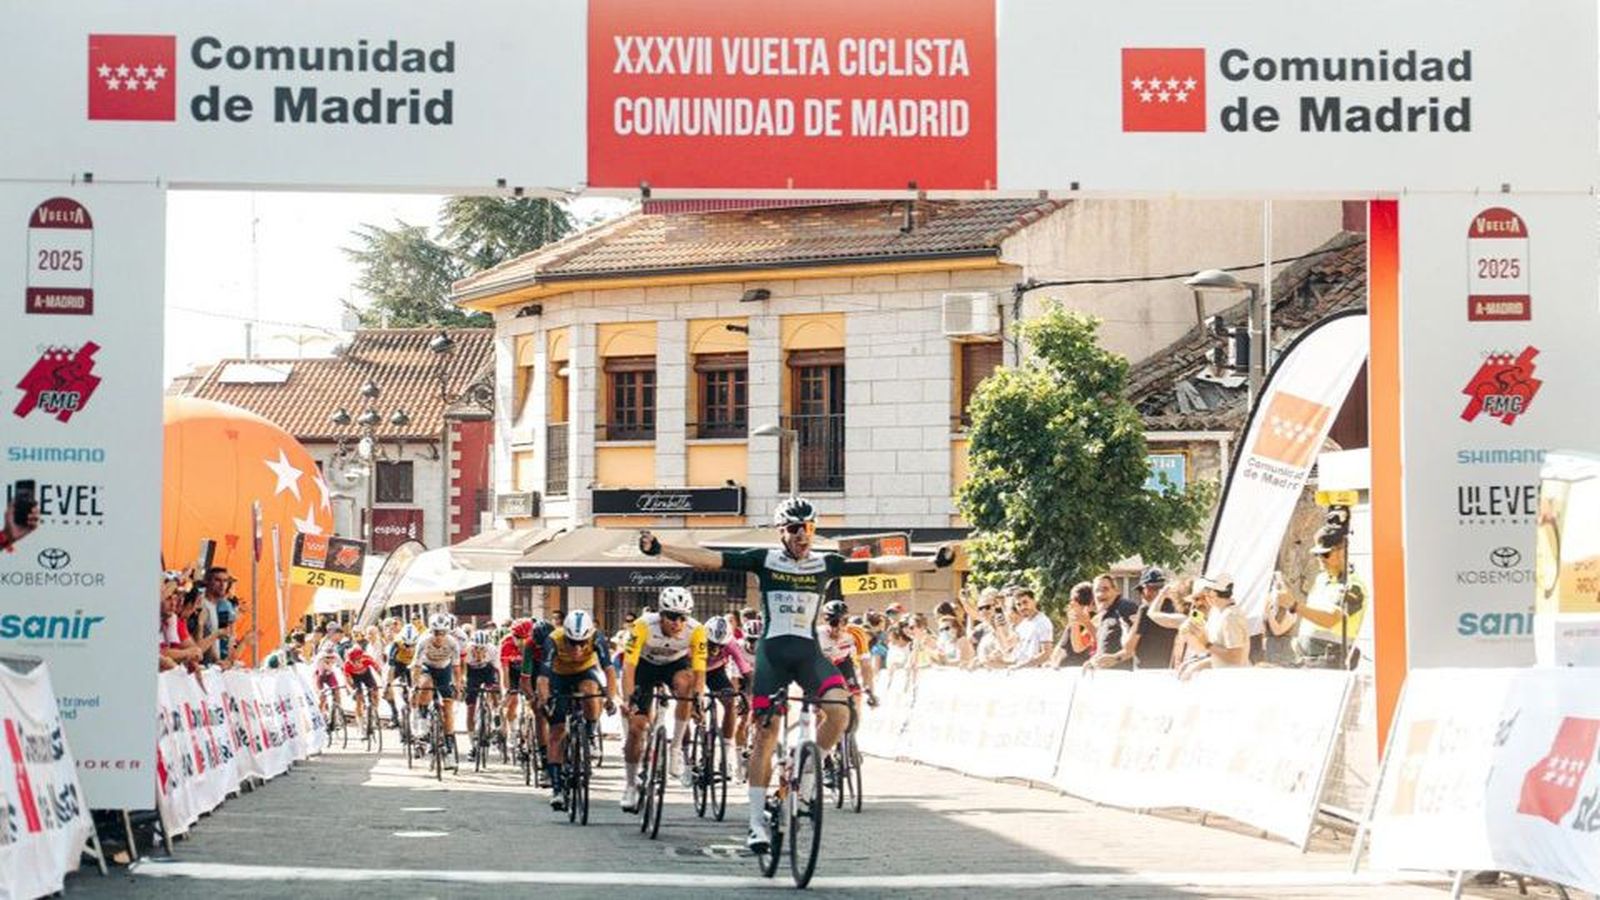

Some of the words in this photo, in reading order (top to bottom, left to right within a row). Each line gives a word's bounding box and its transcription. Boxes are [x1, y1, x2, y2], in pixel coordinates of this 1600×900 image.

[190, 36, 455, 74] Comunidad
[613, 35, 713, 75] XXXVII
[722, 37, 830, 76] VUELTA
[838, 38, 970, 77] CICLISTA
[1219, 48, 1472, 83] Comunidad
[190, 86, 254, 123] de
[274, 86, 454, 126] Madrid
[613, 96, 795, 136] COMUNIDAD
[804, 98, 843, 137] DE
[851, 98, 970, 138] MADRID
[1220, 96, 1280, 133] de
[1299, 96, 1471, 133] Madrid
[38, 249, 83, 272] 2025
[1477, 258, 1521, 279] 2025
[34, 295, 85, 309] A-MADRID
[37, 391, 80, 409] FMC
[1483, 396, 1522, 413] FMC
[8, 446, 105, 463] SHIMANO
[1458, 485, 1542, 516] ULEVE
[374, 526, 407, 536] espiga
[0, 572, 105, 587] KOBEMOTOR
[306, 571, 326, 587] 25
[330, 577, 345, 590] m
[858, 577, 877, 590] 25
[882, 578, 898, 589] m
[0, 609, 105, 640] sanir
[1457, 606, 1533, 636] sani
[63, 695, 100, 708] travel
